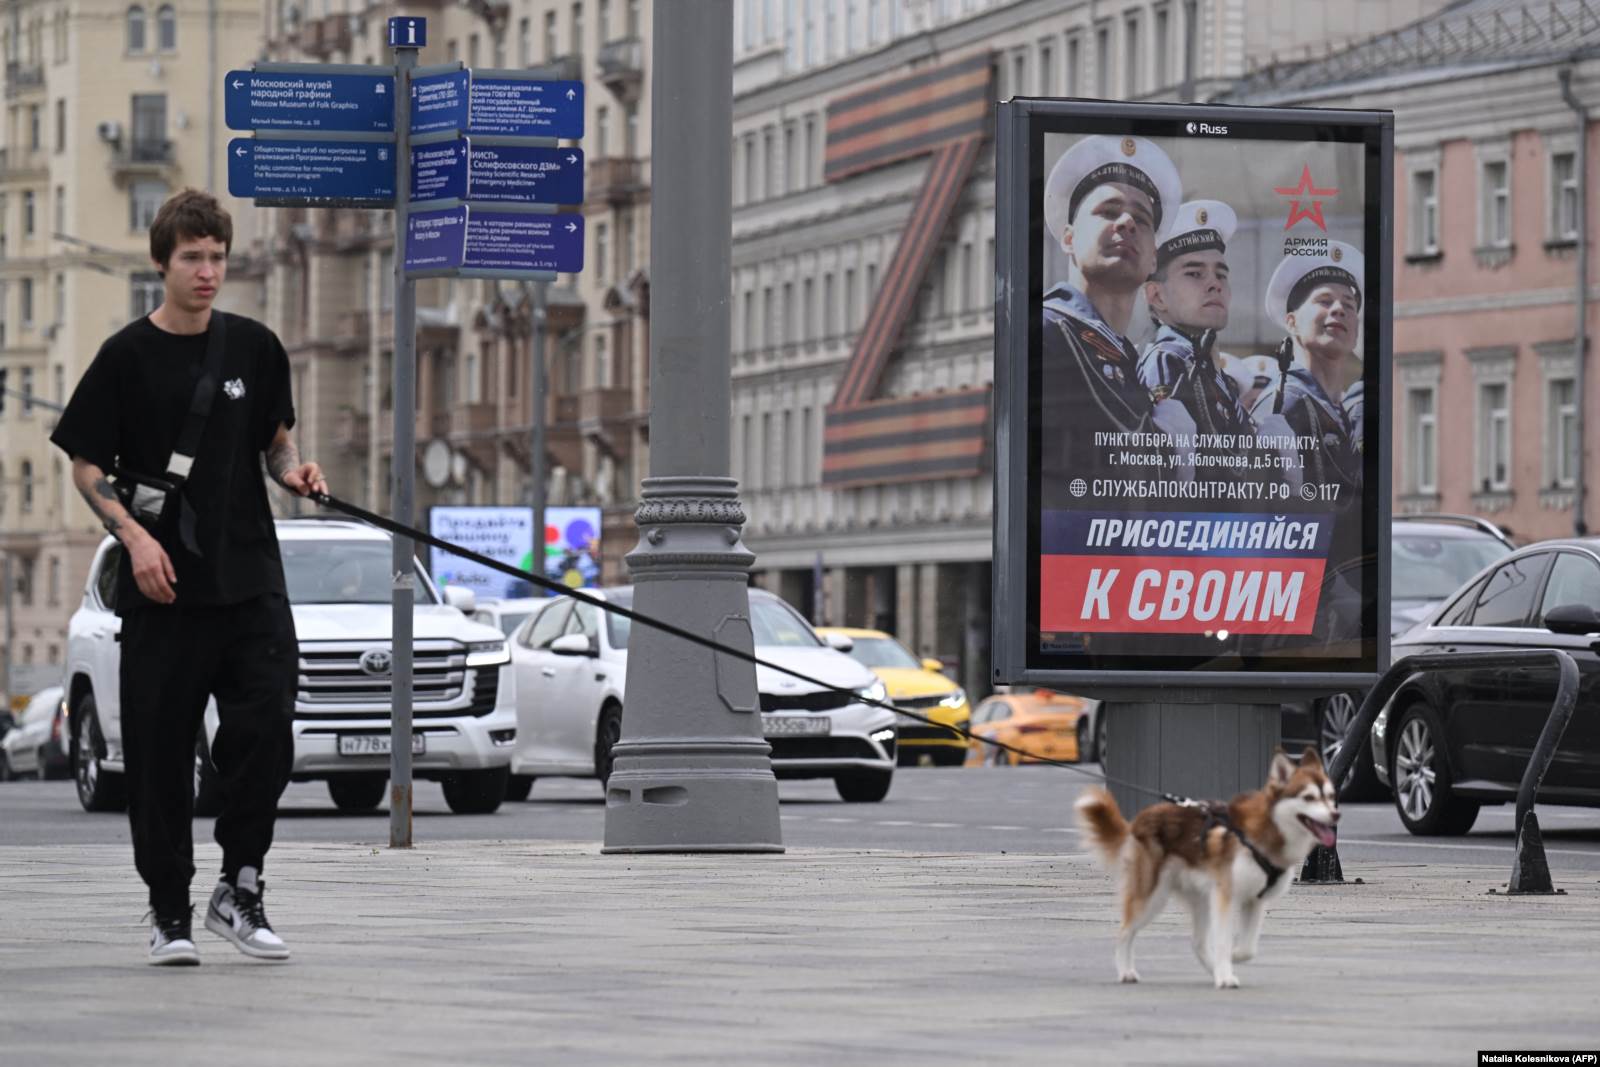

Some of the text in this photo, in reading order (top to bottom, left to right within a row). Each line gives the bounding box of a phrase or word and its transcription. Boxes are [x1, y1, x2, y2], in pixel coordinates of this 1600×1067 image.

[250, 79, 332, 90] Московский музей
[251, 88, 332, 99] народной графики
[331, 102, 359, 110] Graphics
[1200, 123, 1228, 134] Russ
[254, 146, 301, 154] Общественный
[474, 160, 560, 171] Склифосовского ДЗМ»
[1284, 238, 1328, 246] АРМИЯ
[1284, 248, 1328, 256] РОССИИ
[1095, 432, 1320, 450] ПУНКТ ОТБОРА НА СЛУЖБУ ПО КОНТРАКТУ:
[1109, 452, 1304, 472] г. Москва, ул. Яблочкова, д.5 стр. 1
[1092, 480, 1340, 500] СЛУЖБАПОКОНТРАКТУ.РФ 117
[1086, 516, 1320, 551] ПРИСОЕДИНЯЙСЯ
[1080, 568, 1305, 622] К СВОИМ
